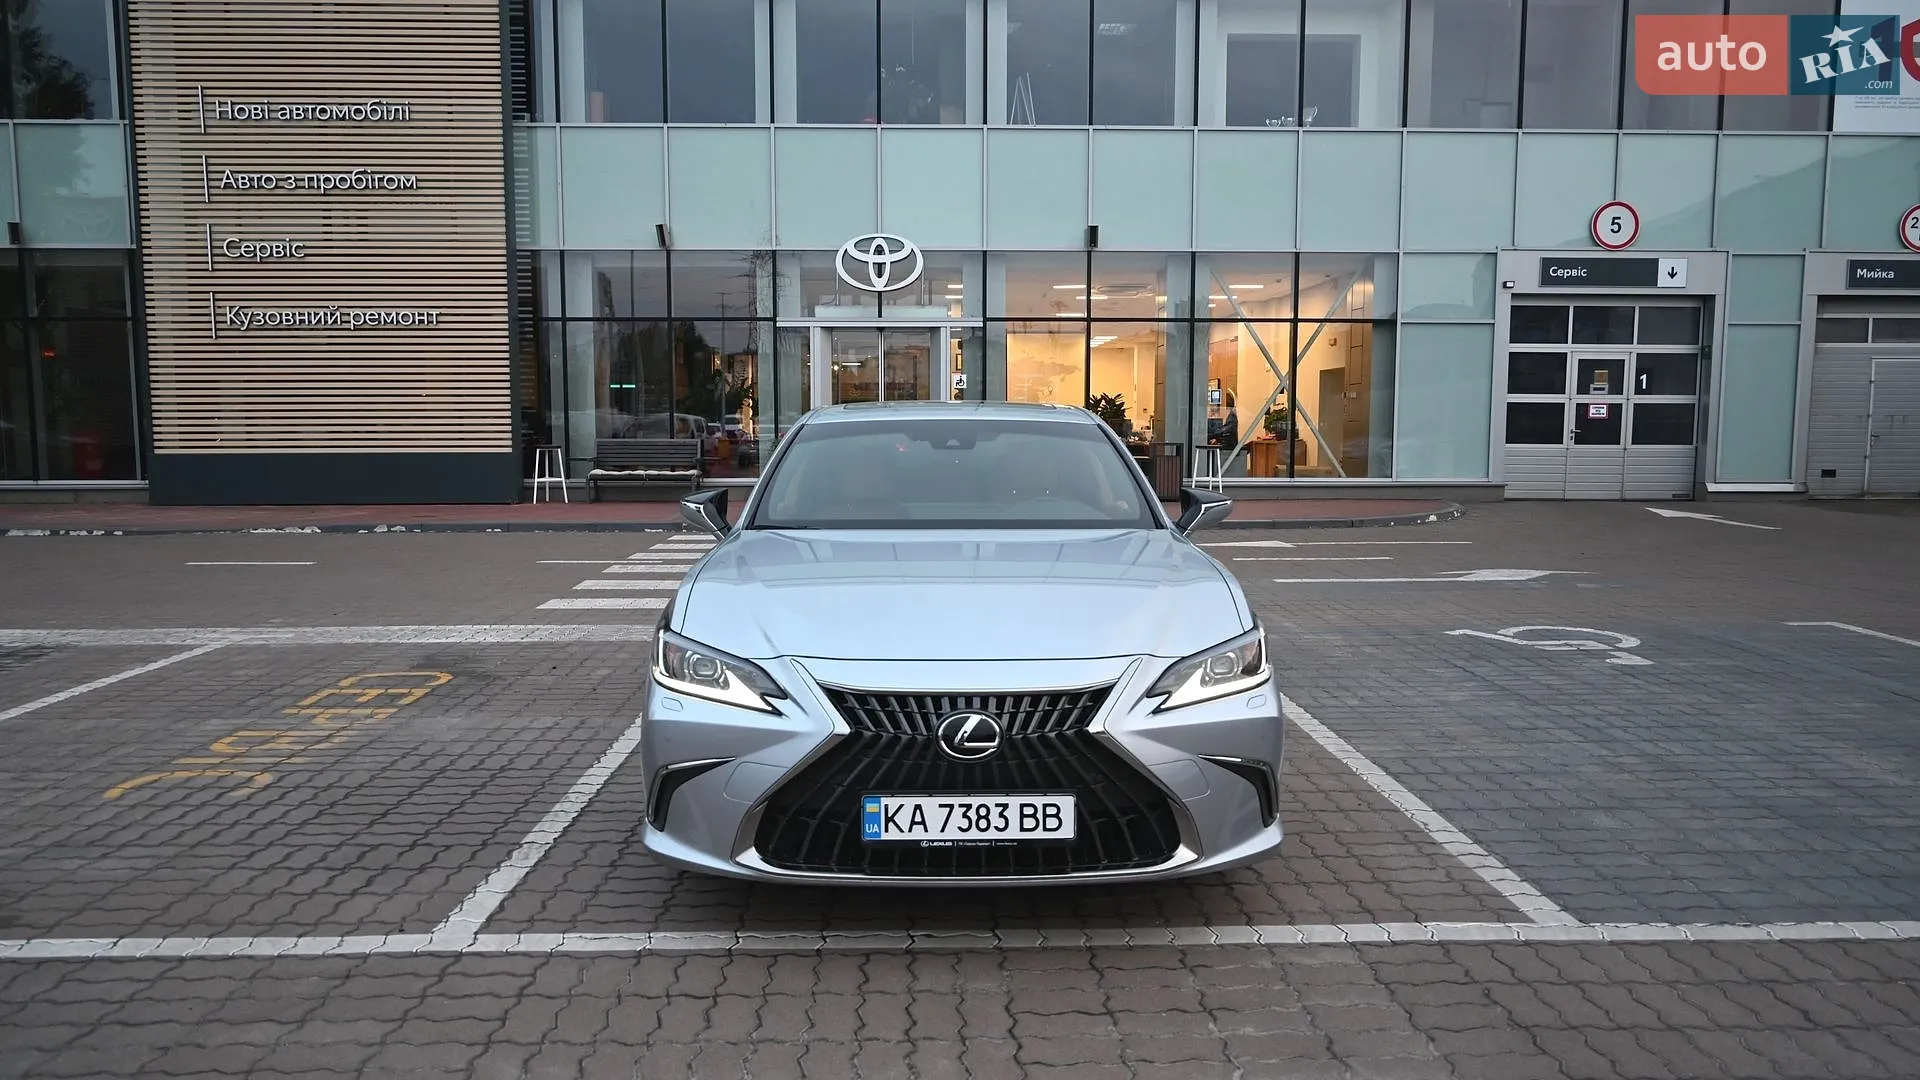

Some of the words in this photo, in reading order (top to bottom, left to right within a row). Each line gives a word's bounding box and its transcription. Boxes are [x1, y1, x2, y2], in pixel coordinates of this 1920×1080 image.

[215, 99, 270, 122] Нові
[277, 99, 411, 122] автомобілі
[220, 169, 277, 191] Авто
[283, 174, 296, 190] з
[304, 169, 418, 194] пробігом
[1610, 215, 1623, 234] 5
[223, 237, 306, 263] Сервіс
[1549, 264, 1588, 280] Сервіс
[1856, 267, 1895, 279] Мийка
[225, 305, 343, 332] Кузовний
[350, 309, 441, 331] ремонт
[1639, 373, 1647, 389] 1
[865, 823, 880, 834] UA
[883, 803, 929, 834] KA
[938, 803, 1010, 833] 7383
[1019, 802, 1063, 833] BB
